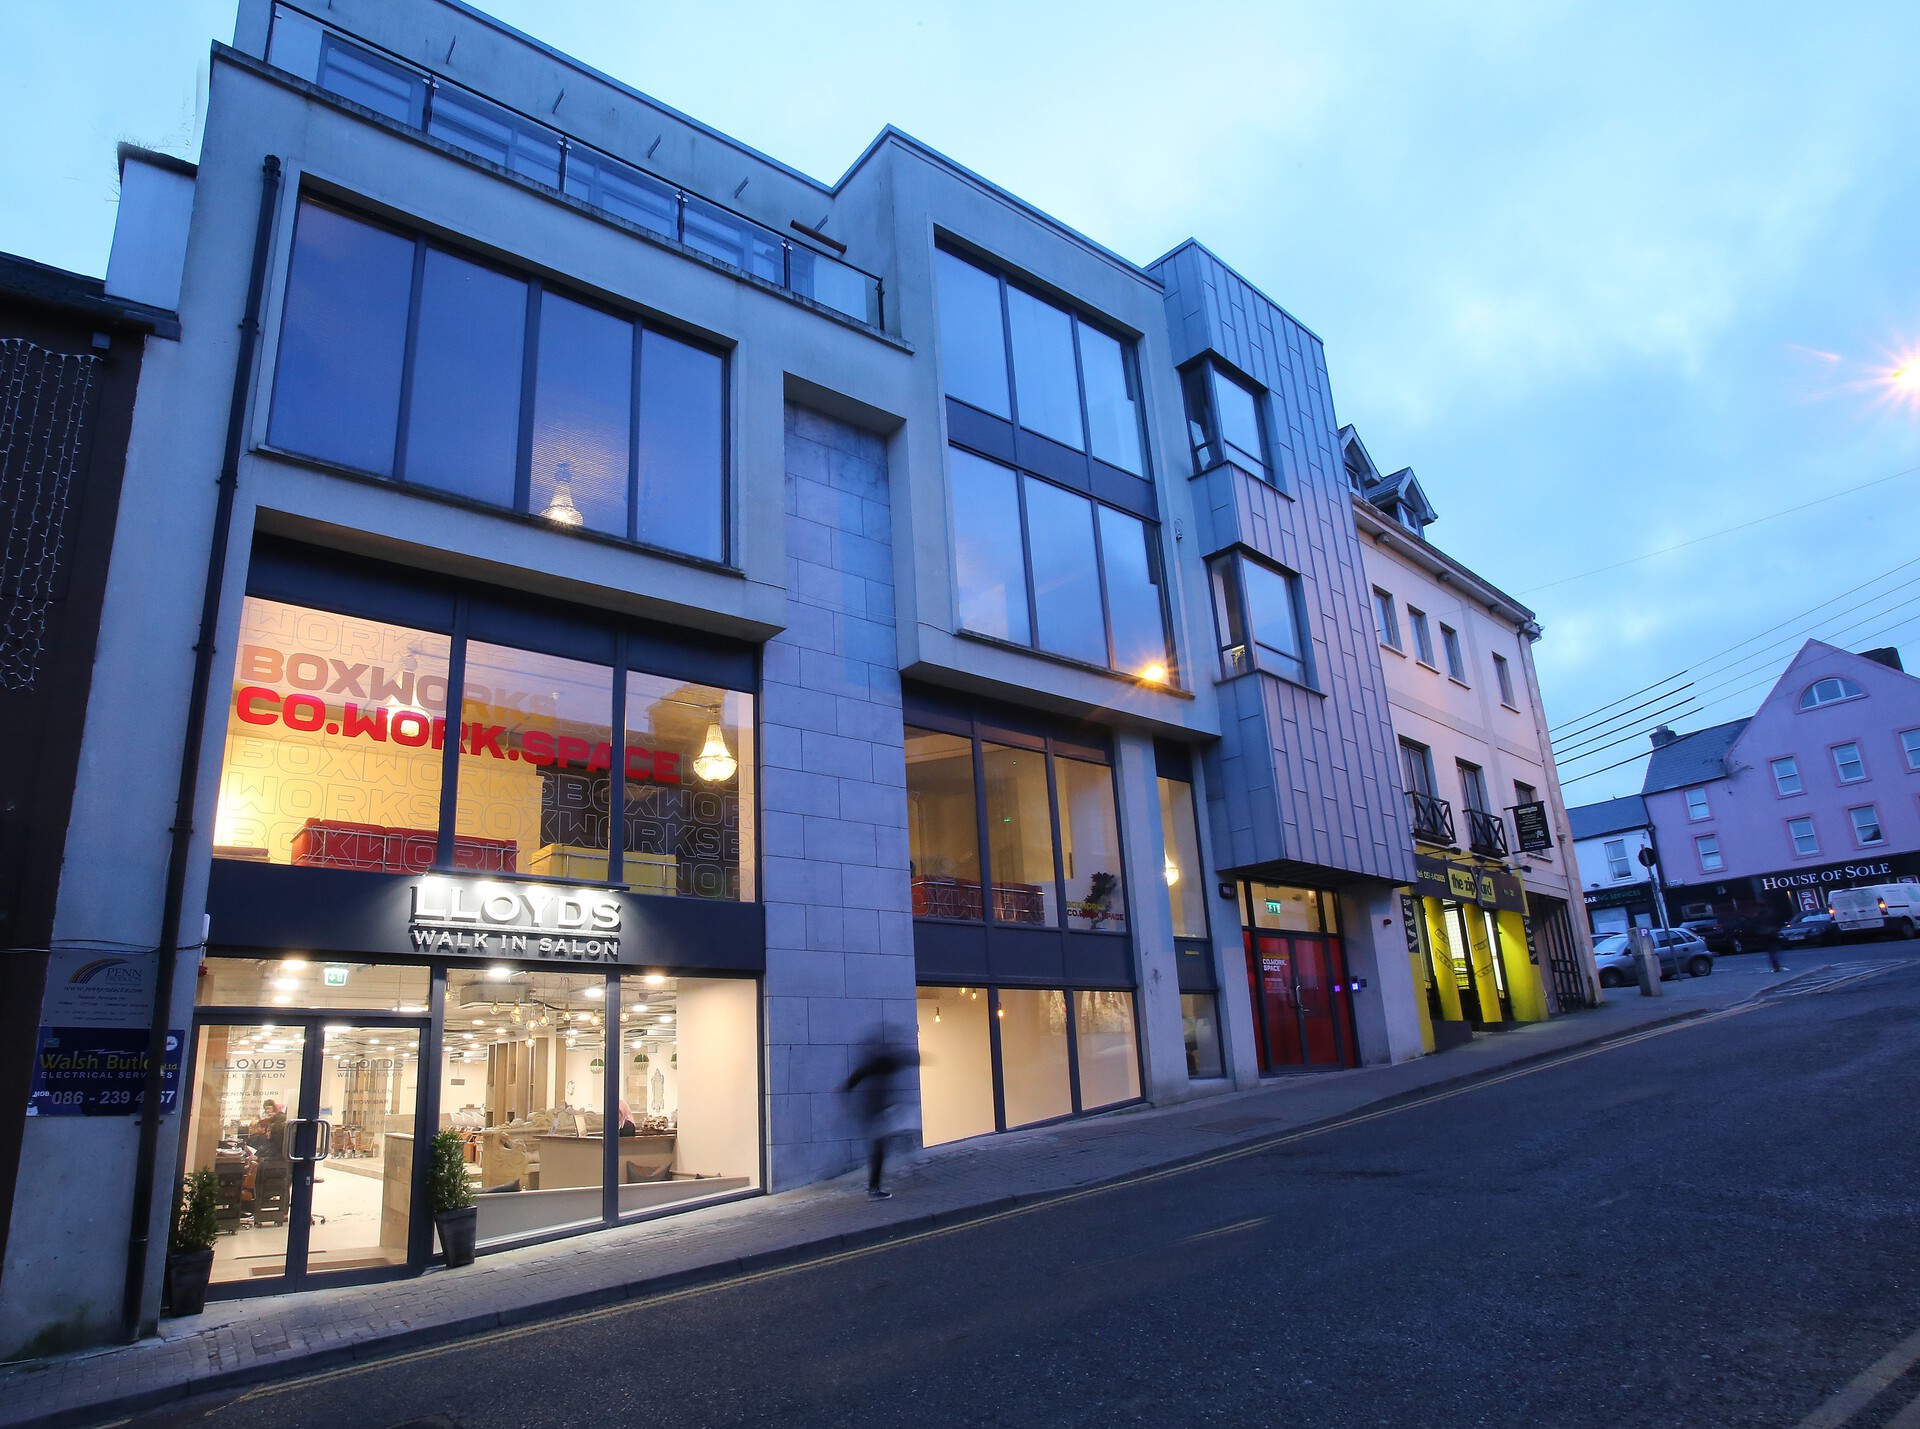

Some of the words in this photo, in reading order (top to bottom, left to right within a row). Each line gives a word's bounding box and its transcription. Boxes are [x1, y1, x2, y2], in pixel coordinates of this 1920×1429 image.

[240, 643, 557, 729] BOXWORKS
[1762, 873, 1819, 890] HOUSE
[1821, 870, 1842, 882] OF
[1845, 862, 1891, 879] SOLE
[412, 883, 622, 931] LLOYDS
[1801, 891, 1815, 911] SAL
[413, 929, 489, 948] WALK
[500, 934, 527, 951] IN
[539, 937, 619, 956] SALON
[107, 968, 142, 977] PENN
[40, 1051, 98, 1070] Walsh
[106, 1052, 149, 1070] Butle
[213, 1059, 287, 1070] LLOYDS
[337, 1059, 404, 1069] LLOYDS
[41, 1071, 113, 1079] ELECTRICAL
[52, 1091, 84, 1104] 086
[100, 1090, 131, 1104] 239
